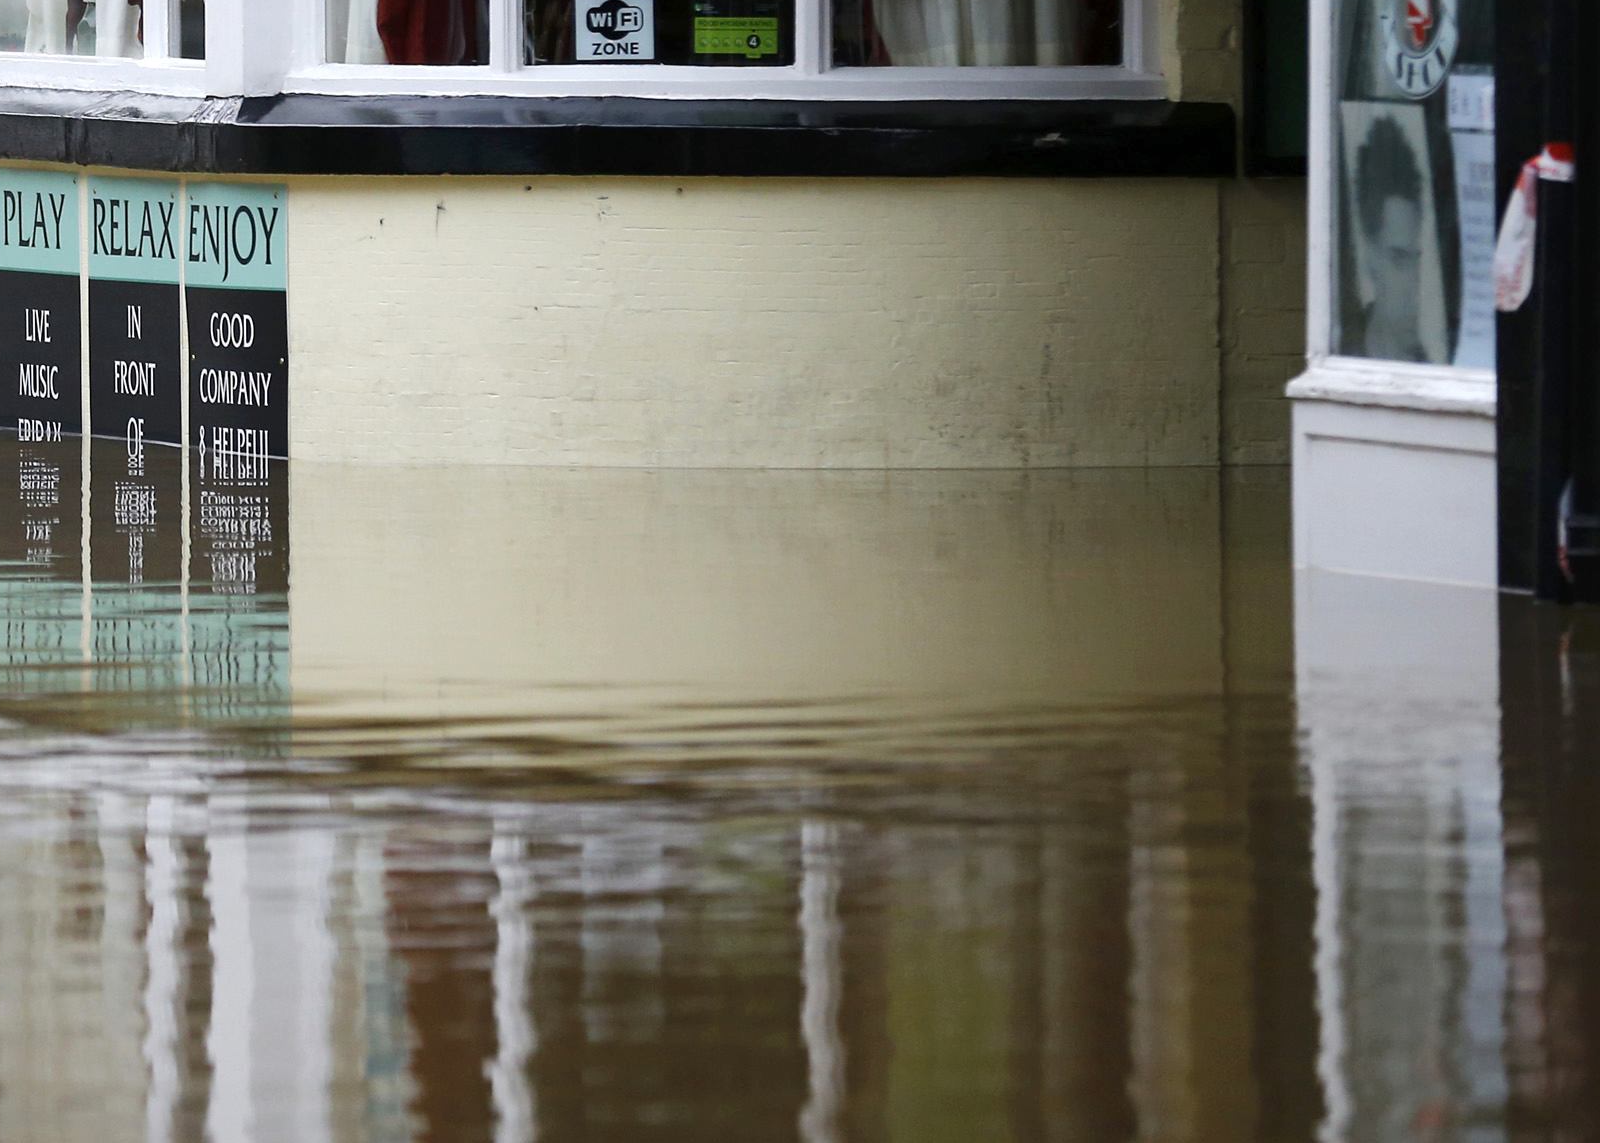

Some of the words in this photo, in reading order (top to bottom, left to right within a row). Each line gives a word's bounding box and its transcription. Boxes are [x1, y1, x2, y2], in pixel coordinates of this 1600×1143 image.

[592, 42, 639, 56] ZONE
[748, 36, 758, 48] 4
[4, 190, 66, 249] PLAY
[93, 197, 176, 259] RELAX
[188, 205, 279, 281] ENJOY
[25, 308, 51, 342] LIVE
[127, 305, 142, 339] IN
[210, 312, 255, 348] GOOD
[19, 364, 59, 400] MUSIC
[114, 362, 156, 397] FRONT
[199, 369, 272, 407] COMPANY
